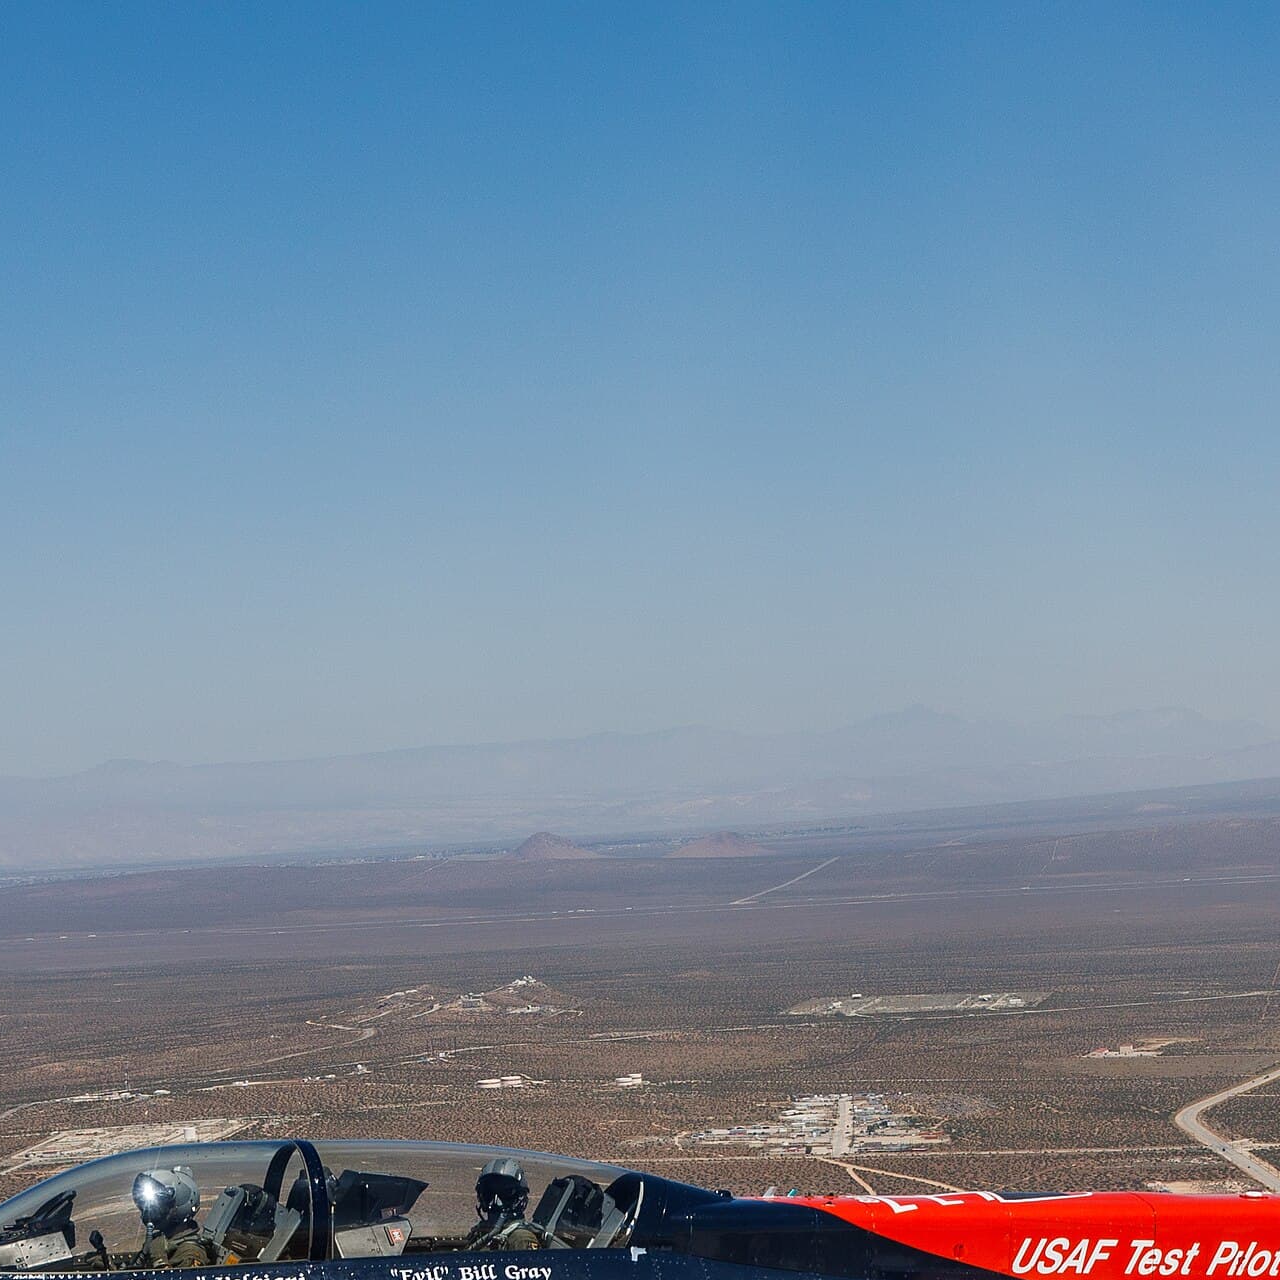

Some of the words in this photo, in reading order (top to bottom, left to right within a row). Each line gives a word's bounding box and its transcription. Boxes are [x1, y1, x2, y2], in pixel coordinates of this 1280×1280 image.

[1011, 1238, 1118, 1275] USAF
[1123, 1239, 1201, 1276] Test
[458, 1264, 498, 1280] Bill
